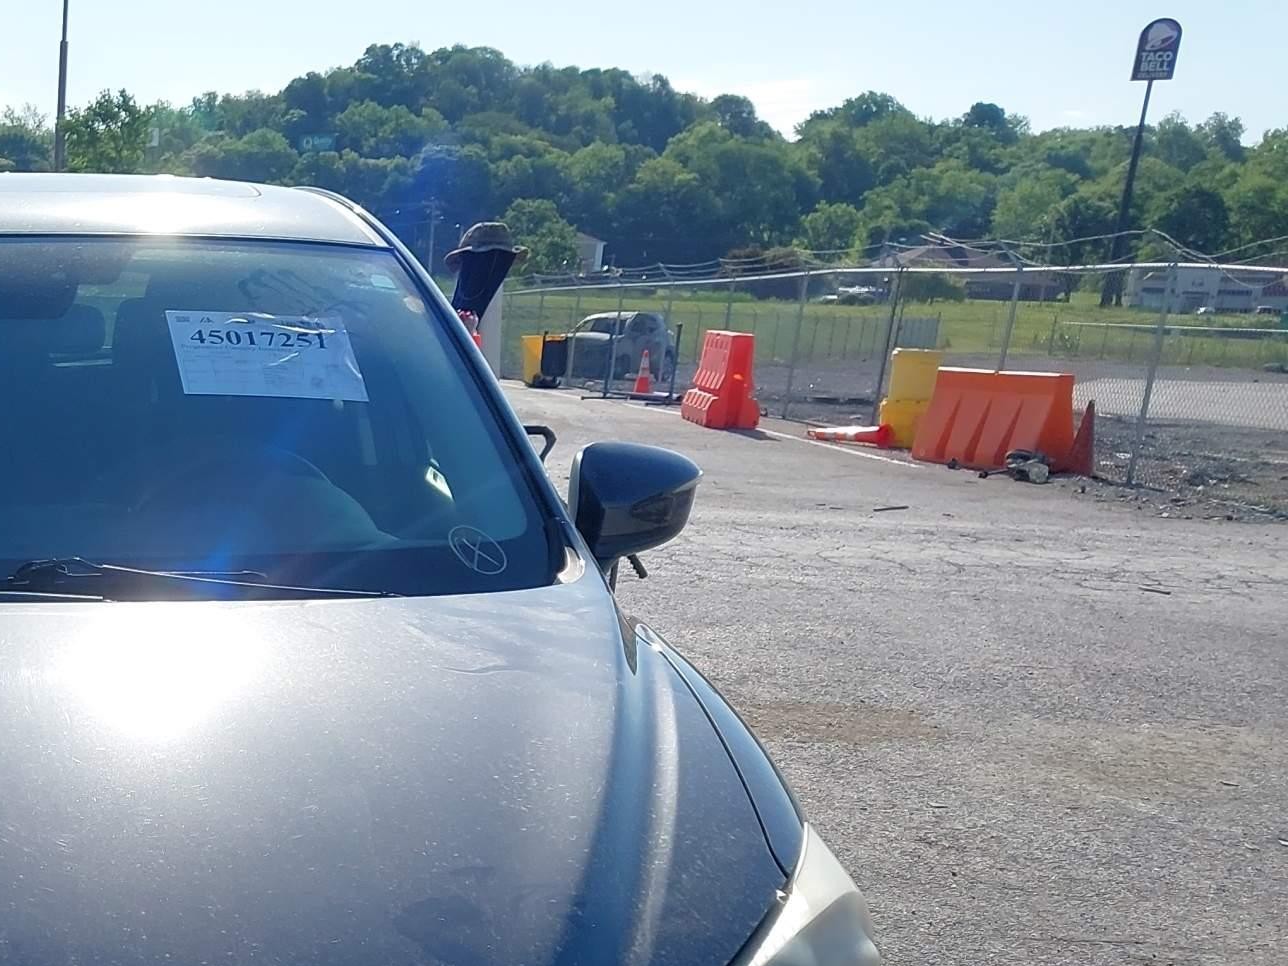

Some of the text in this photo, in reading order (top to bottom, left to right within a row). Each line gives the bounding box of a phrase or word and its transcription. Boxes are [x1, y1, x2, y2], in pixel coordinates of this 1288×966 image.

[1141, 51, 1173, 61] TACO
[1140, 61, 1169, 71] BELL
[190, 329, 329, 349] 45017251
